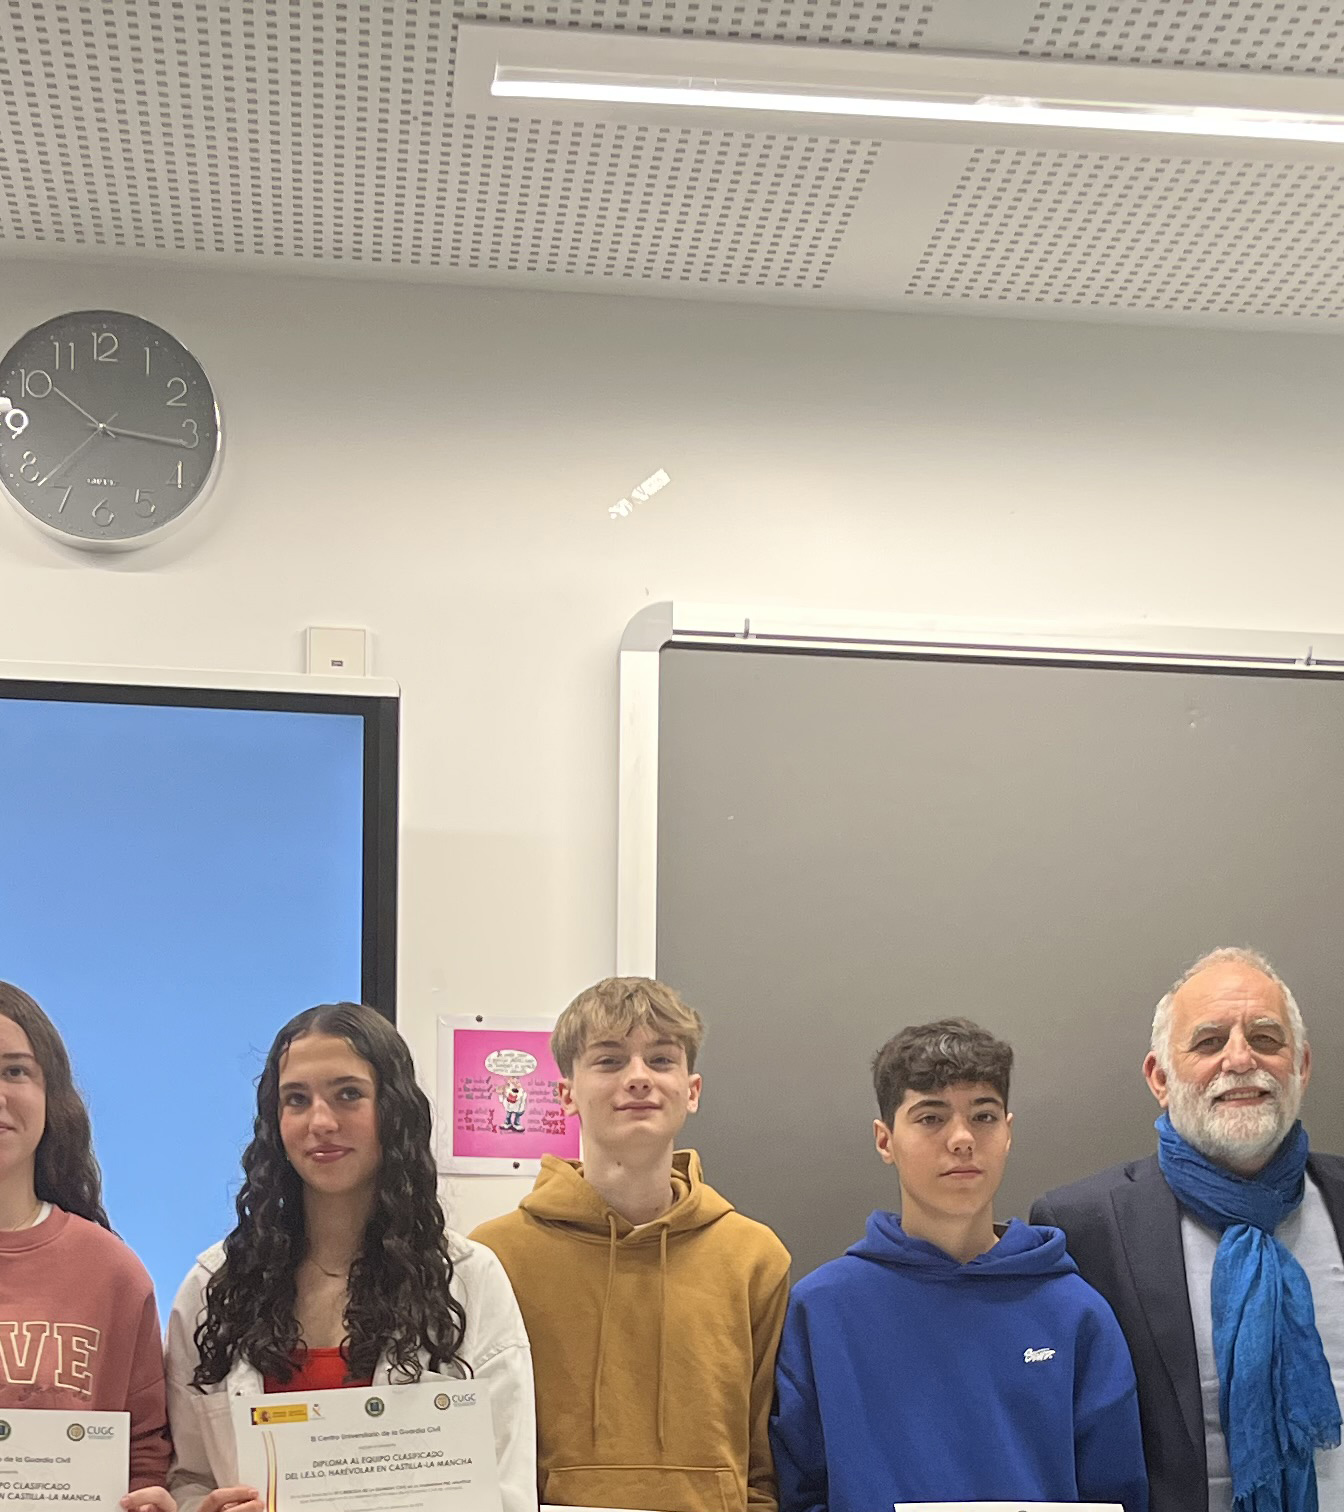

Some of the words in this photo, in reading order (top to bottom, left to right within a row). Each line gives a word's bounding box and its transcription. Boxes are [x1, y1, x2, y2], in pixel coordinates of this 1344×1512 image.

[53, 342, 75, 370] 11
[91, 332, 119, 362] 12
[144, 347, 150, 376] 1
[19, 369, 52, 398] 10
[166, 377, 188, 407] 2
[5, 408, 29, 440] 9
[181, 418, 199, 449] 3
[19, 451, 40, 483] 8
[165, 460, 183, 489] 4
[51, 485, 73, 514] 7
[91, 499, 115, 527] 6
[135, 488, 156, 519] 5
[86, 1425, 115, 1436] CUGC
[285, 1472, 299, 1480] DEL
[376, 1464, 387, 1472] EN
[436, 1457, 473, 1467] MANCHA
[312, 1458, 348, 1468] DIPLOMA
[350, 1457, 360, 1465] AL
[361, 1454, 390, 1464] EQUIPO
[392, 1450, 444, 1462] CLASIFICADO
[13, 1482, 71, 1490] CLASIFICADO
[61, 1493, 102, 1502] MANCHA
